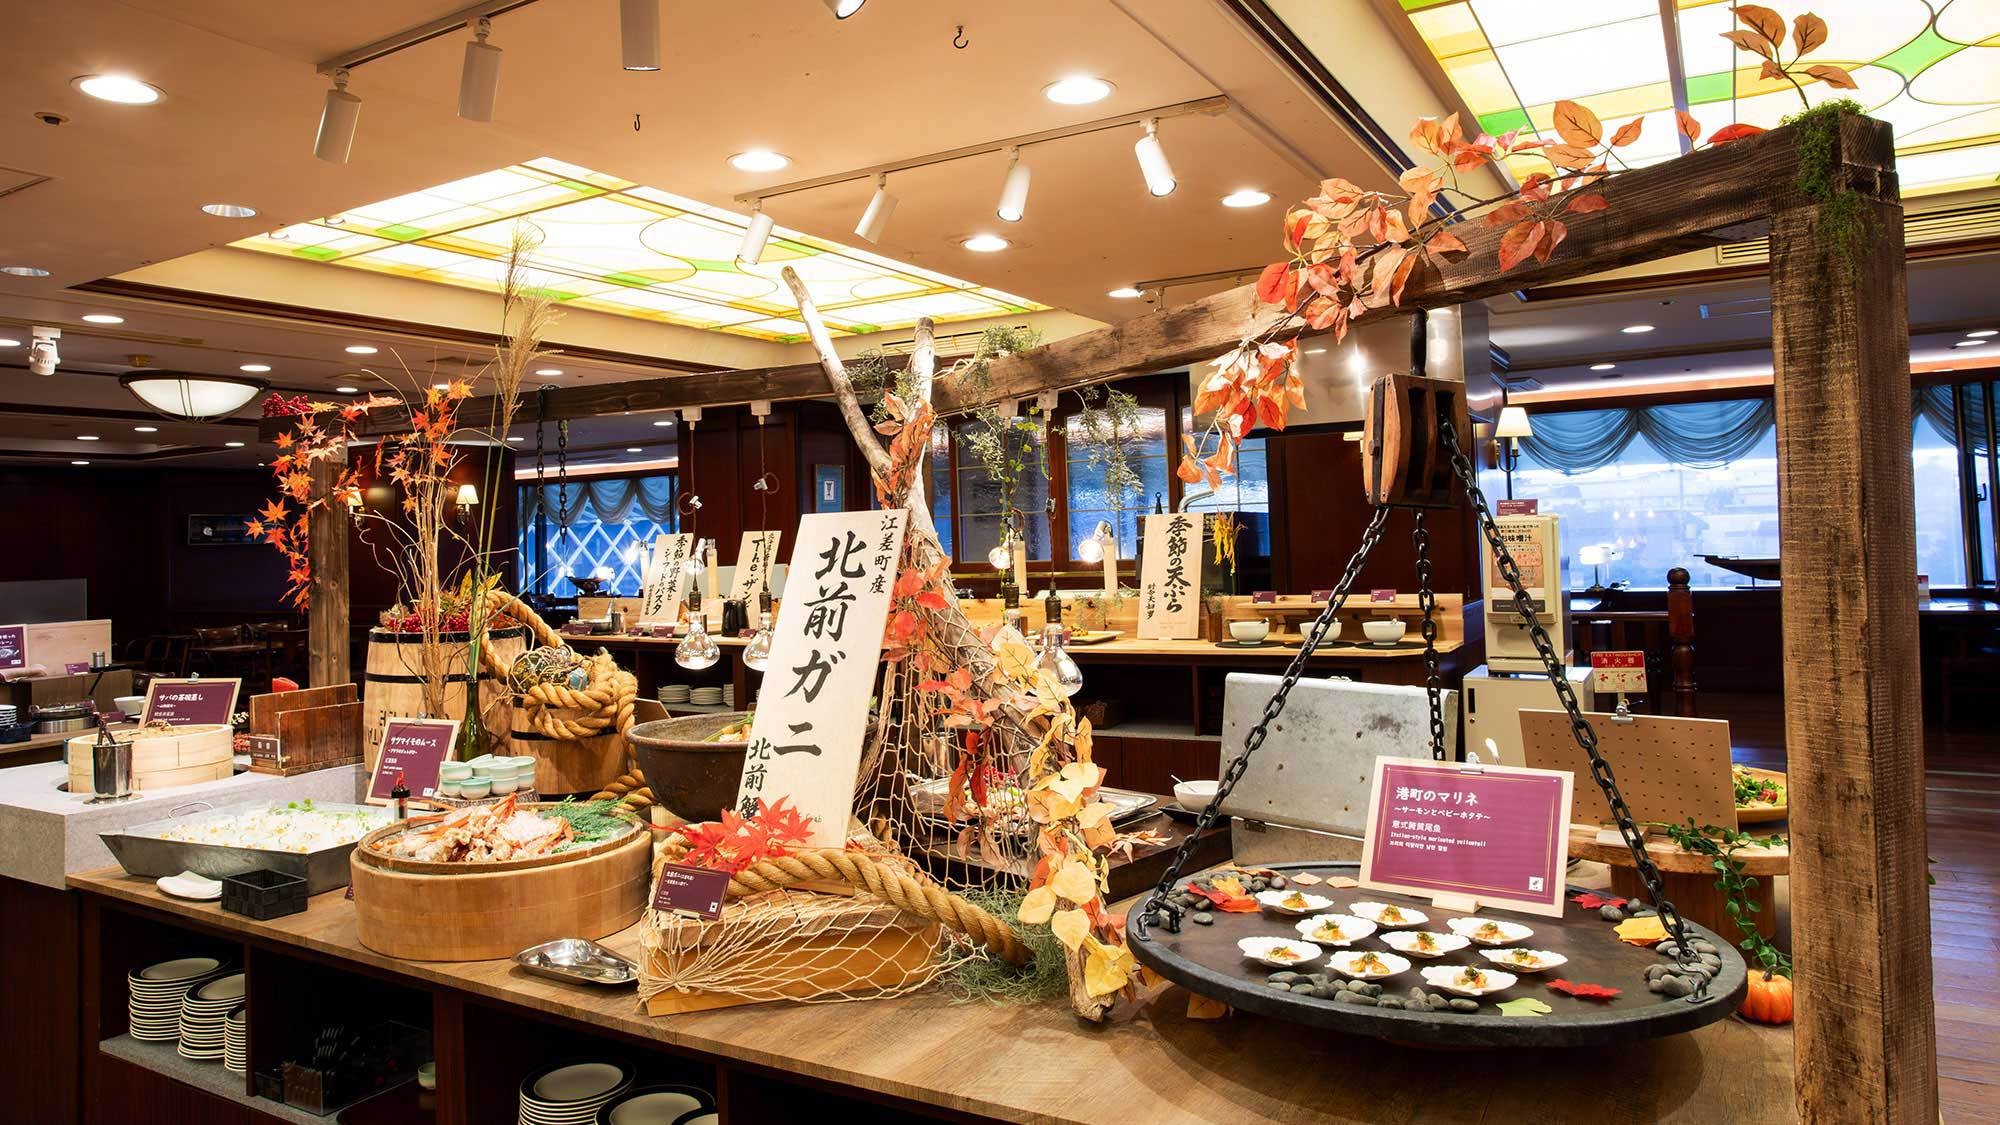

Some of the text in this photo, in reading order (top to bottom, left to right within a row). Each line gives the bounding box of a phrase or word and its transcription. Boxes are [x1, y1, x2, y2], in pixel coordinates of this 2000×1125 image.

[869, 515, 898, 595] 江差町産
[1164, 516, 1193, 613] 季節の天ぷら
[773, 530, 868, 757] 北前ガニ
[1396, 786, 1479, 807] 港町のマリネ
